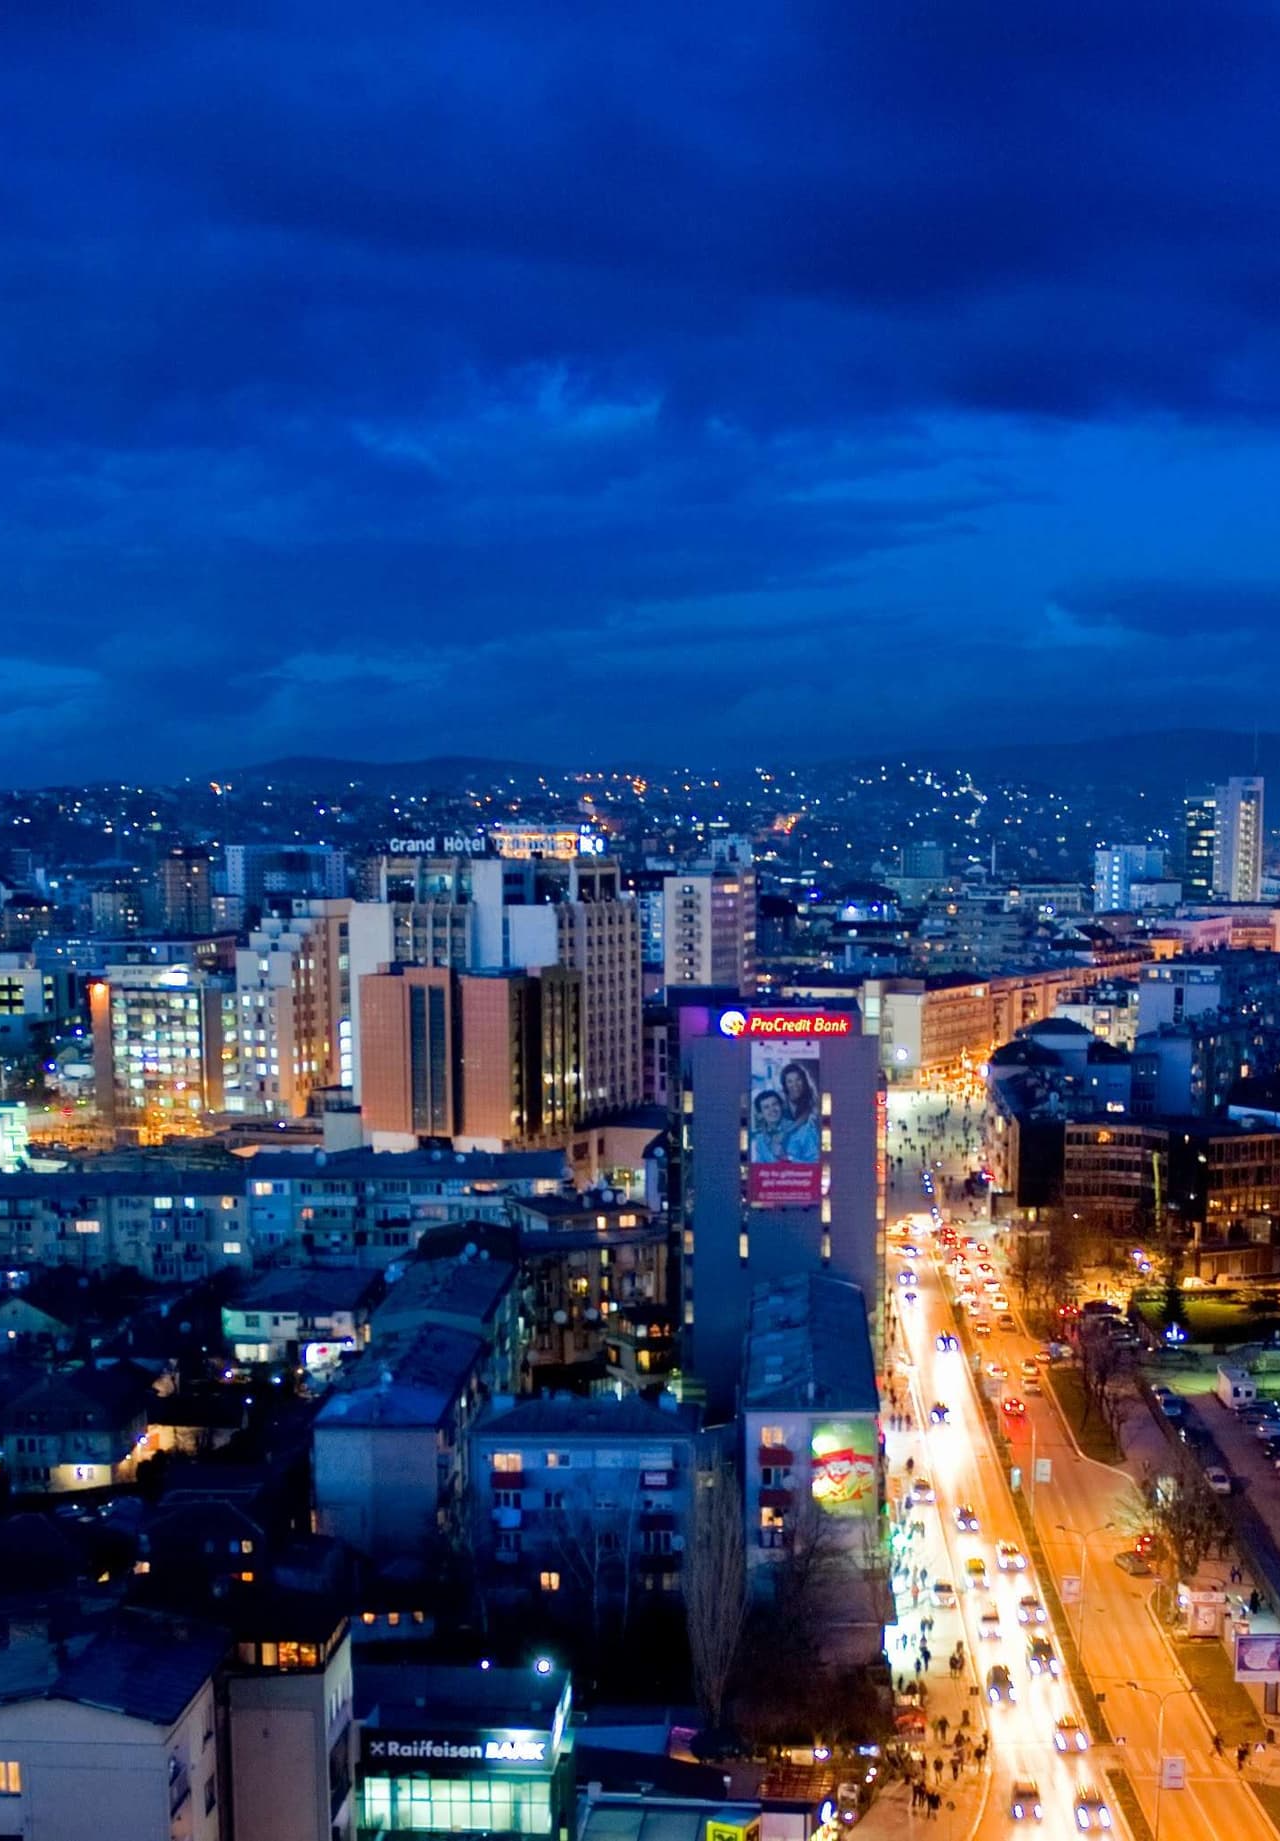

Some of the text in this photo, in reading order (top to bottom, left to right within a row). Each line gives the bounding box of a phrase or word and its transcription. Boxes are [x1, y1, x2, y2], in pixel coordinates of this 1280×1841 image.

[390, 837, 435, 853] Grand
[443, 836, 486, 852] Hotel
[750, 1017, 848, 1033] ProCredit Bank
[387, 1740, 546, 1761] Raiffeisen BANK
